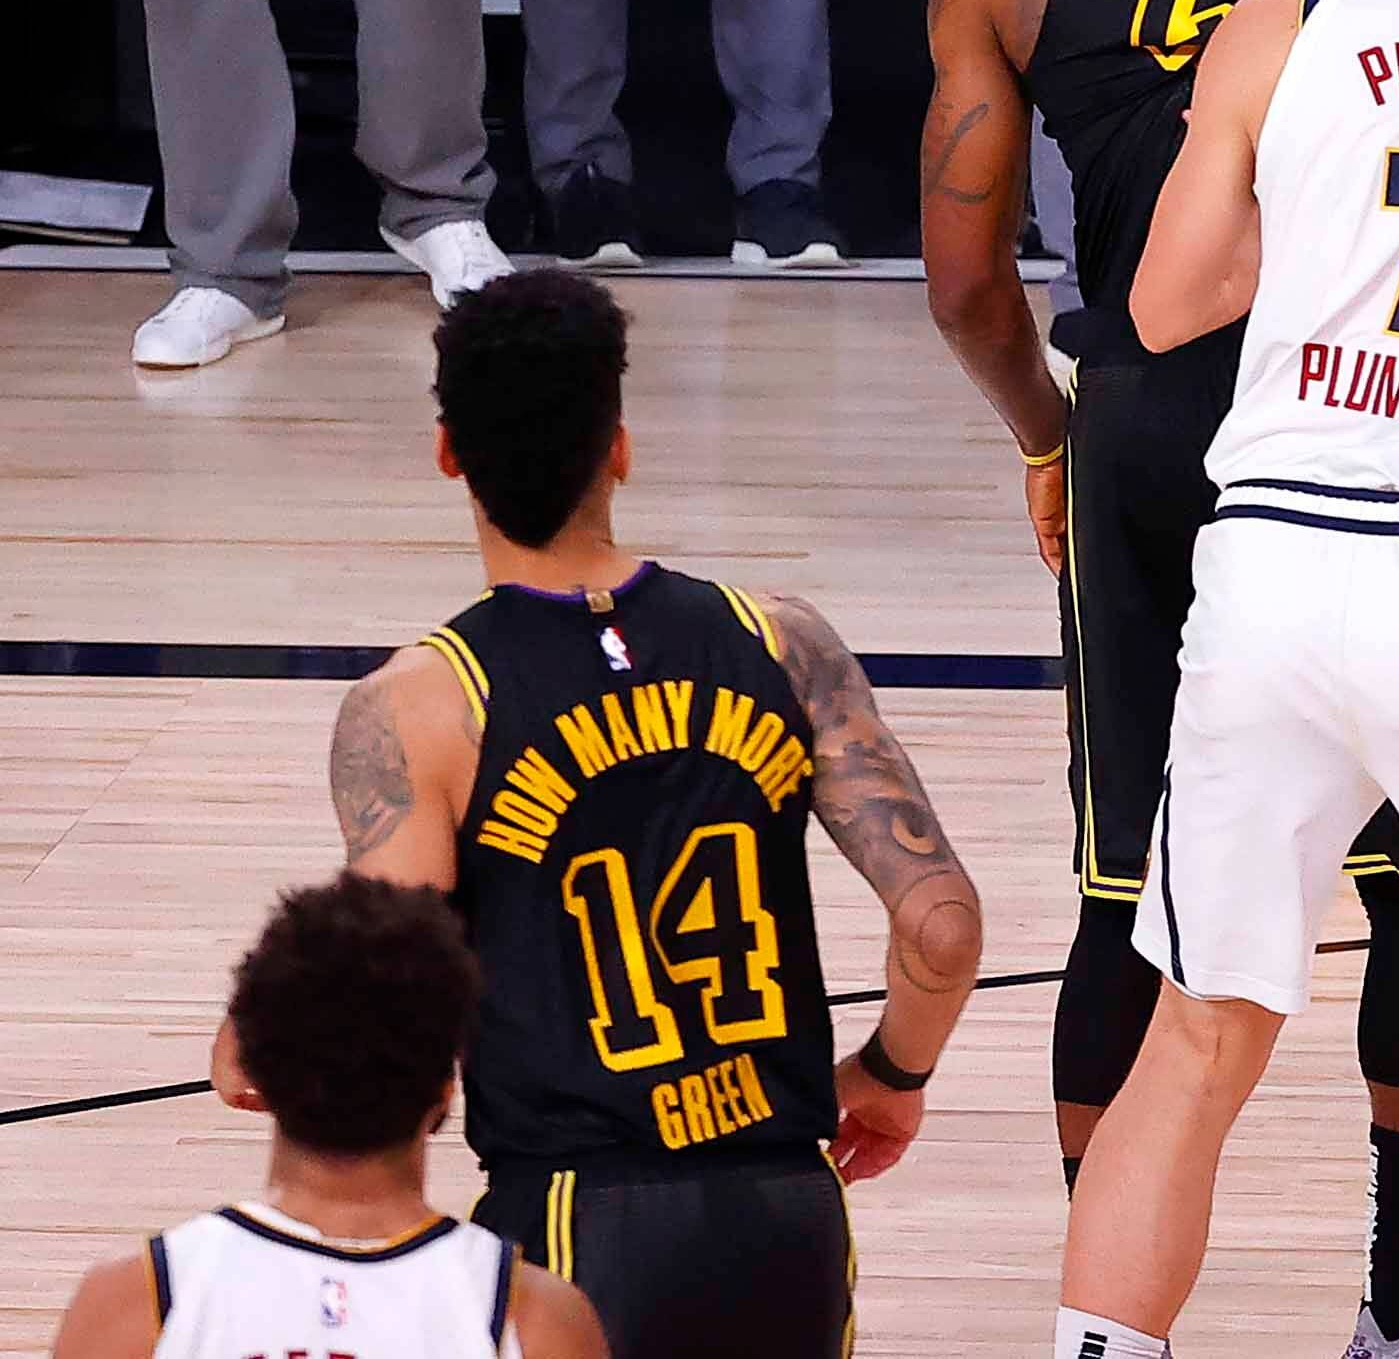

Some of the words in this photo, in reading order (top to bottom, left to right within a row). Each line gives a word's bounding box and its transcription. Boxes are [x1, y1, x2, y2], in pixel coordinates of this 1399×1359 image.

[477, 745, 579, 865] HOW
[553, 679, 694, 779] MANY
[561, 821, 787, 1073] 14
[651, 1052, 774, 1151] GREEN
